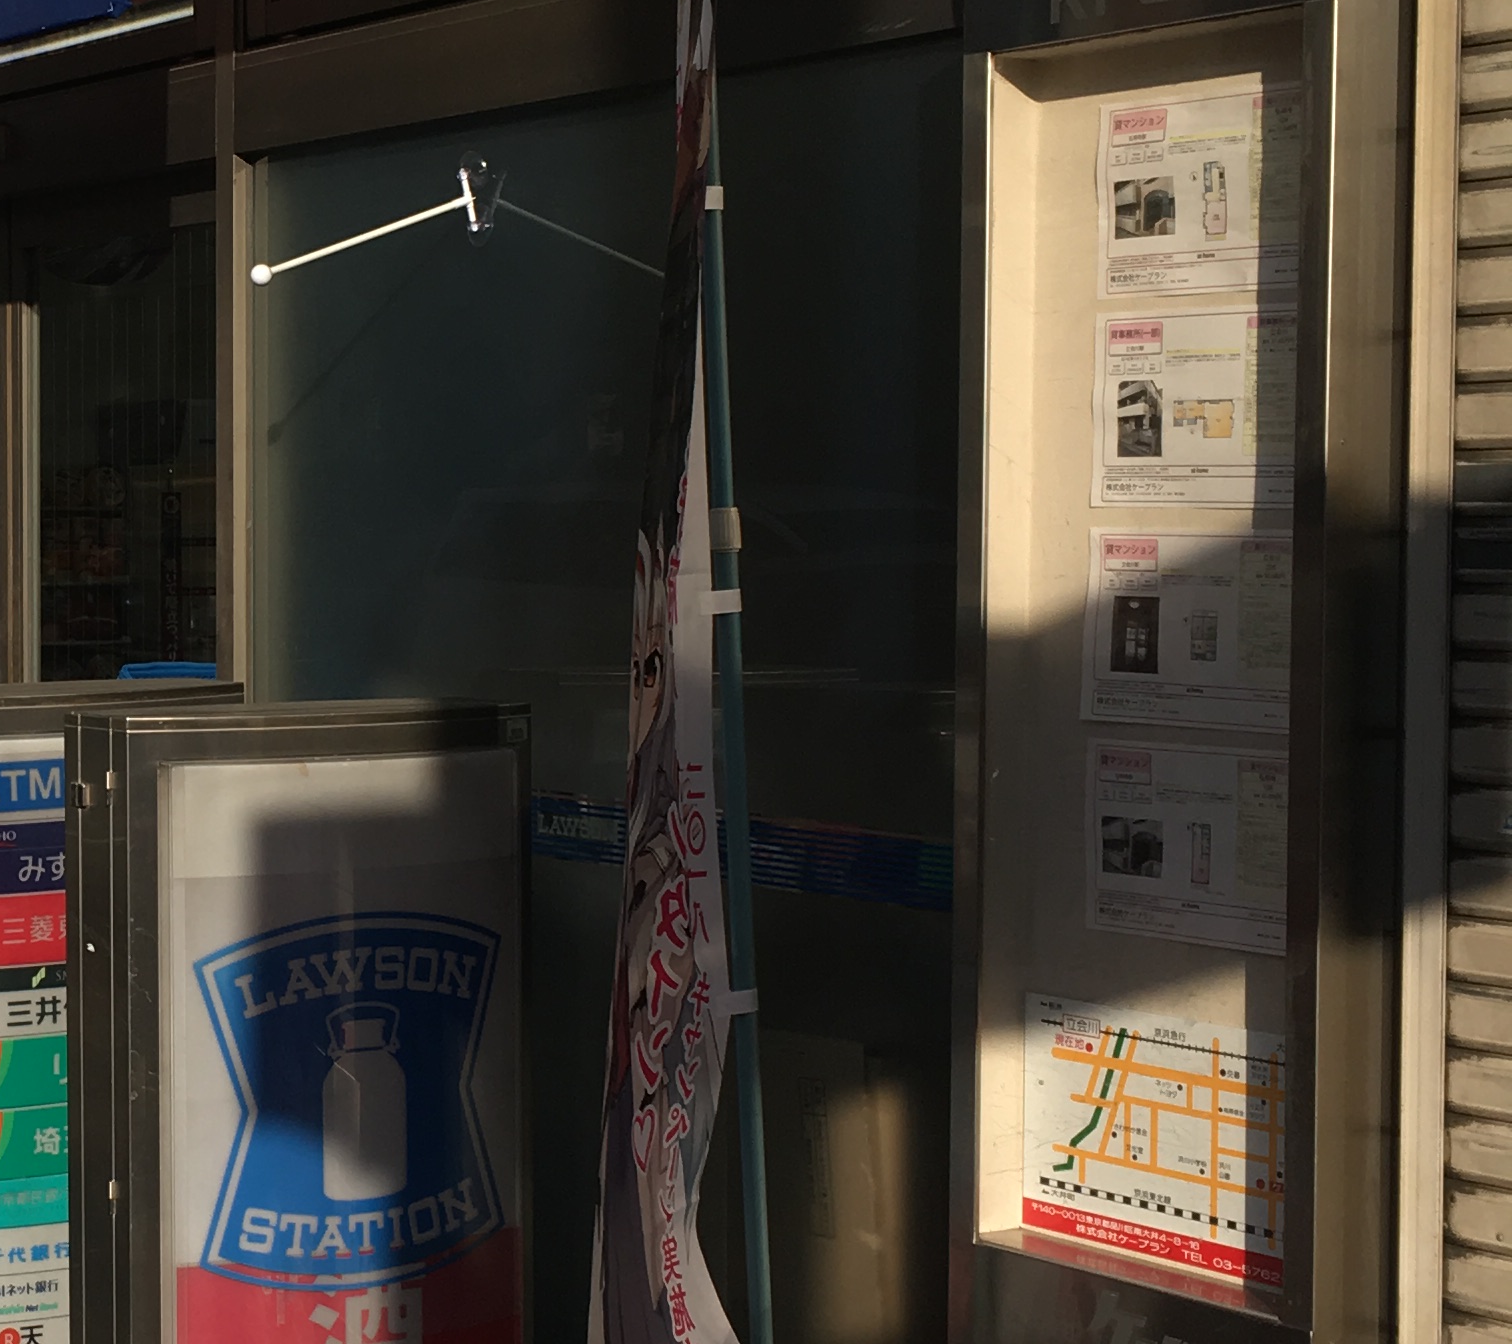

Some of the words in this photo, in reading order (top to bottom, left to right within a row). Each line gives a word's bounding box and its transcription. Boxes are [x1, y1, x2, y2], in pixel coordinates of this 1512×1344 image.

[1113, 115, 1165, 131] 貸マンション
[1110, 272, 1167, 283] 株式会社ケープラン
[1105, 543, 1156, 555] 貸マンション
[232, 945, 480, 1019] LAWSON
[7, 996, 67, 1026] 三井
[1066, 1018, 1098, 1035] 立会川
[1154, 1027, 1186, 1042] 京浜急行
[1055, 1033, 1084, 1050] 現在地
[33, 1125, 68, 1156] 埼
[1050, 1188, 1076, 1202] 大井町
[237, 1178, 480, 1261] STATION
[1076, 1223, 1170, 1254] 株式会社ケープラン
[1182, 1248, 1208, 1265] TEL
[25, 1303, 39, 1313] Net
